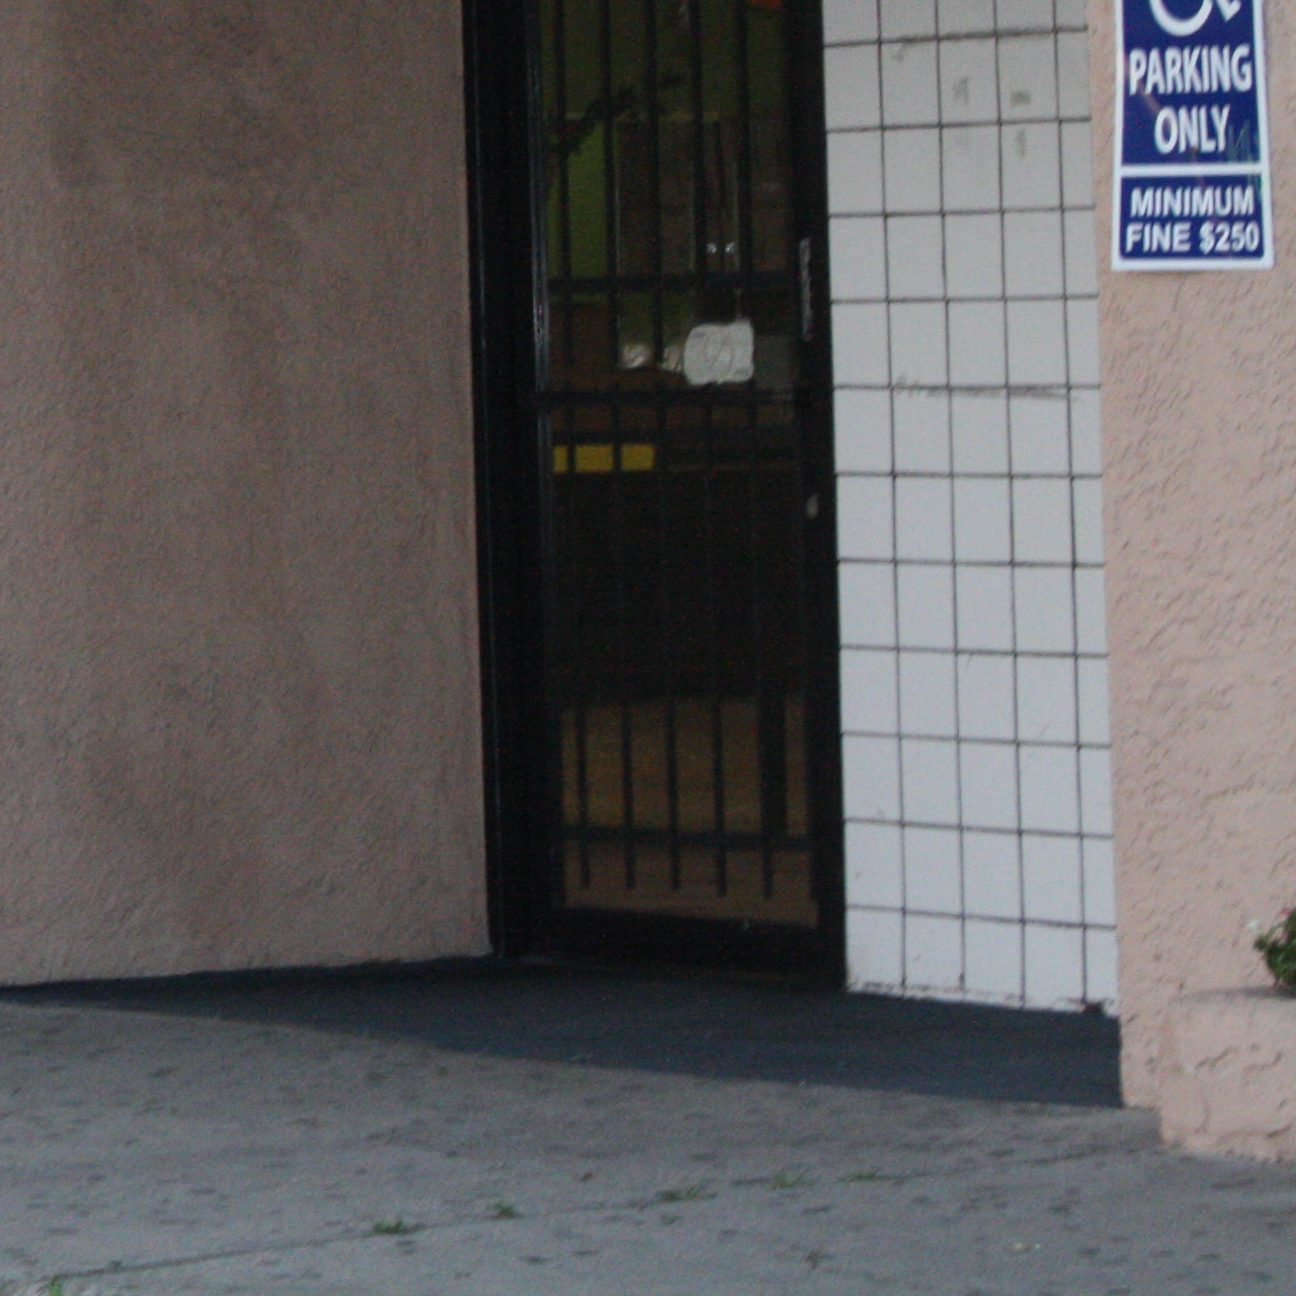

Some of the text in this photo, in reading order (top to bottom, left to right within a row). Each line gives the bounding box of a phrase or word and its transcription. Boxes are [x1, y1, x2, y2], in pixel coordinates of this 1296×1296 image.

[1129, 43, 1253, 96] PARKING
[1154, 105, 1231, 154] ONLY
[1130, 184, 1255, 218] MINIMUM
[1125, 219, 1260, 255] FINE $250
